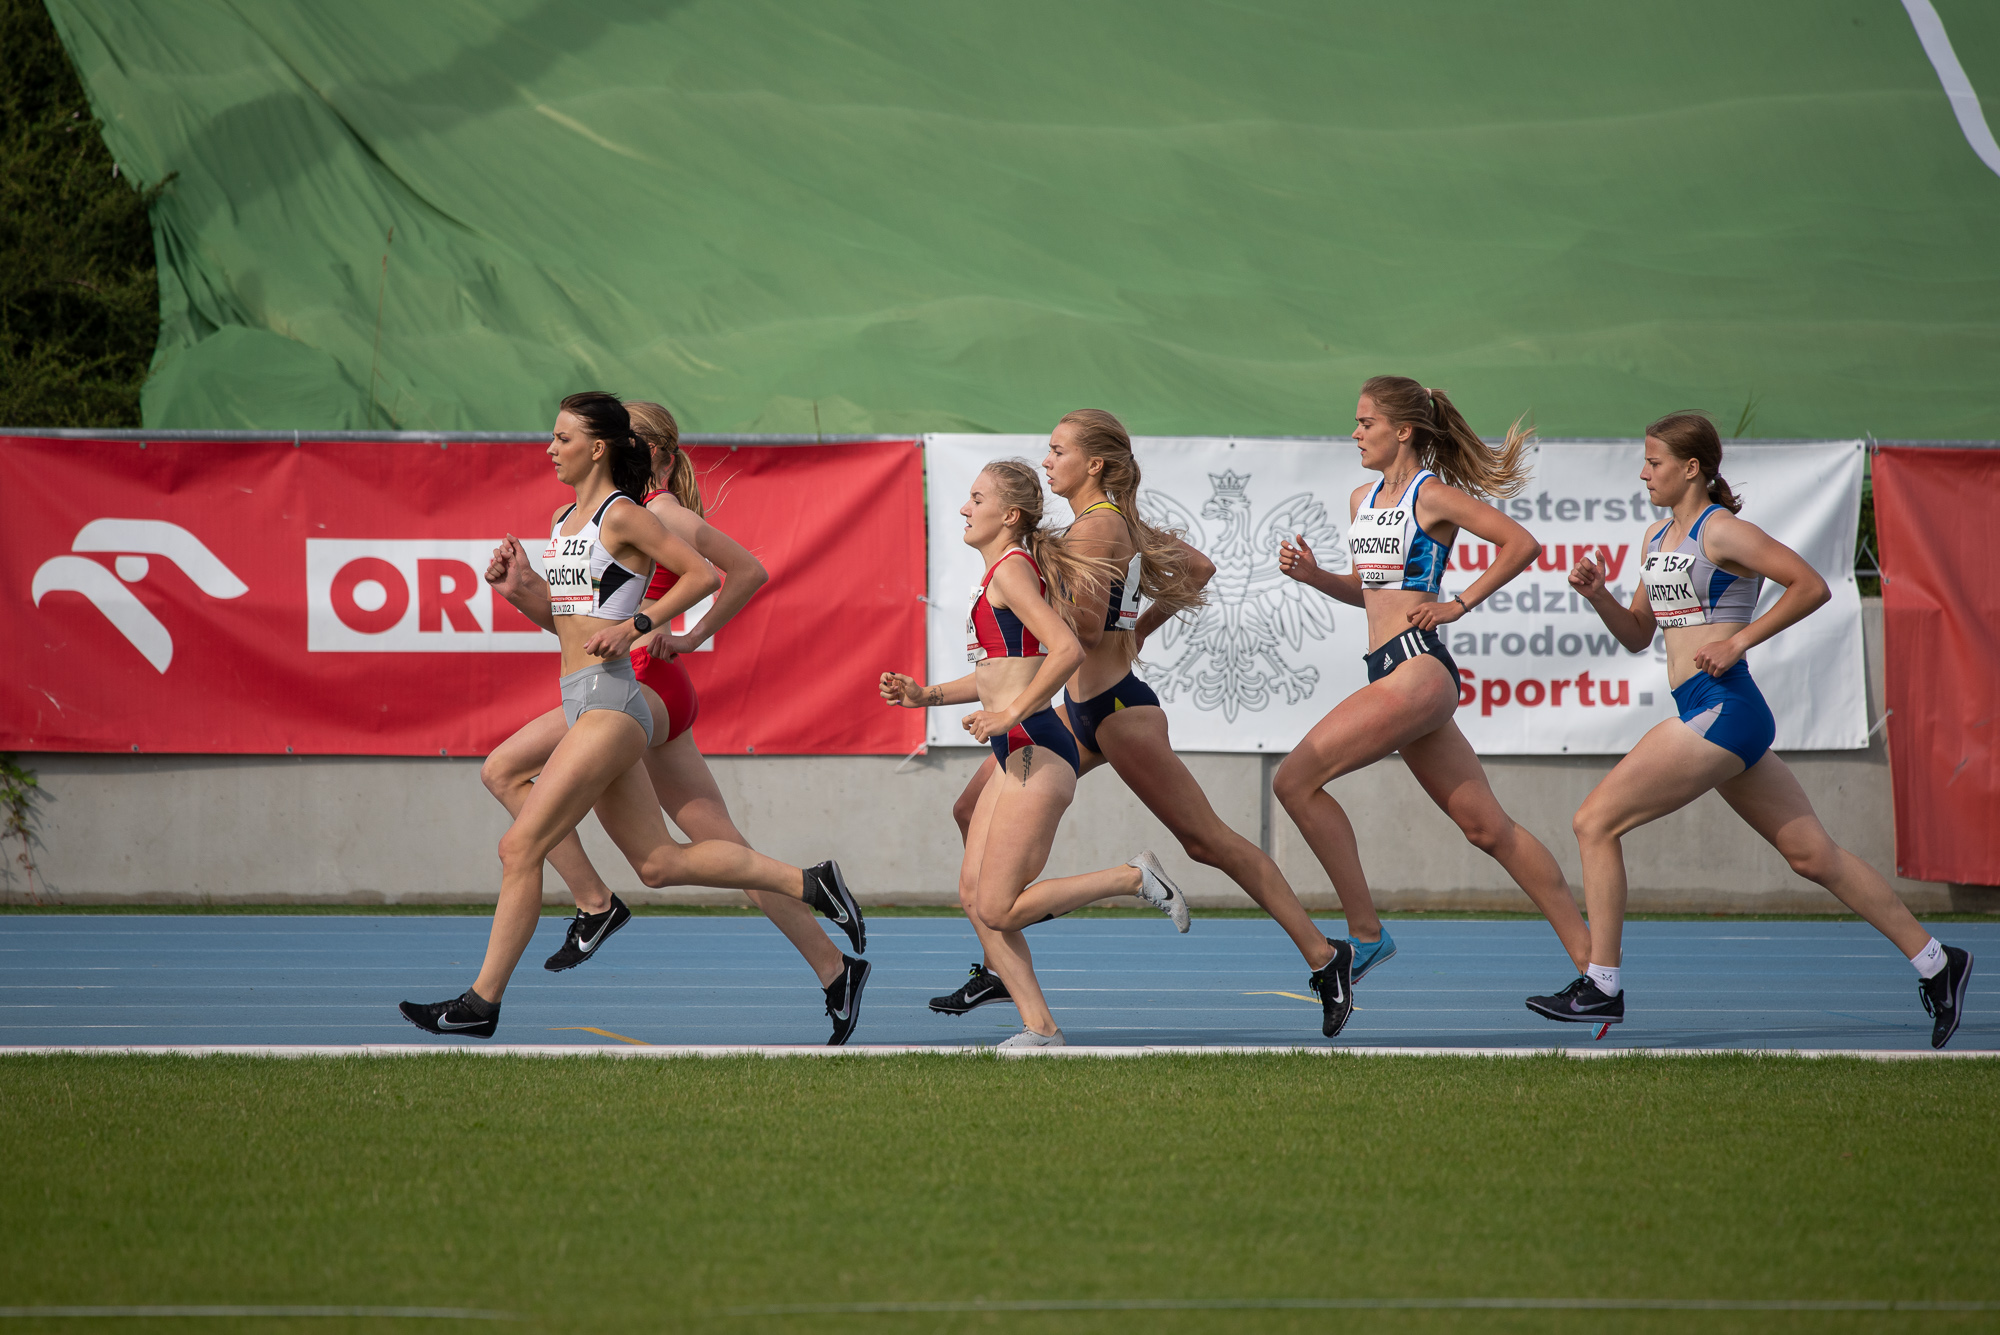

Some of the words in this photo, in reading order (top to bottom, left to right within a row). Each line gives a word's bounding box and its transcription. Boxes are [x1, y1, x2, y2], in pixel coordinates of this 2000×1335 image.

[1377, 510, 1405, 526] 619
[562, 539, 587, 556] 215
[1446, 543, 1629, 583] uury
[1663, 556, 1689, 572] 154
[546, 565, 588, 585] GUŚCIK
[1366, 571, 1385, 579] 2021
[1670, 617, 1687, 627] 2021
